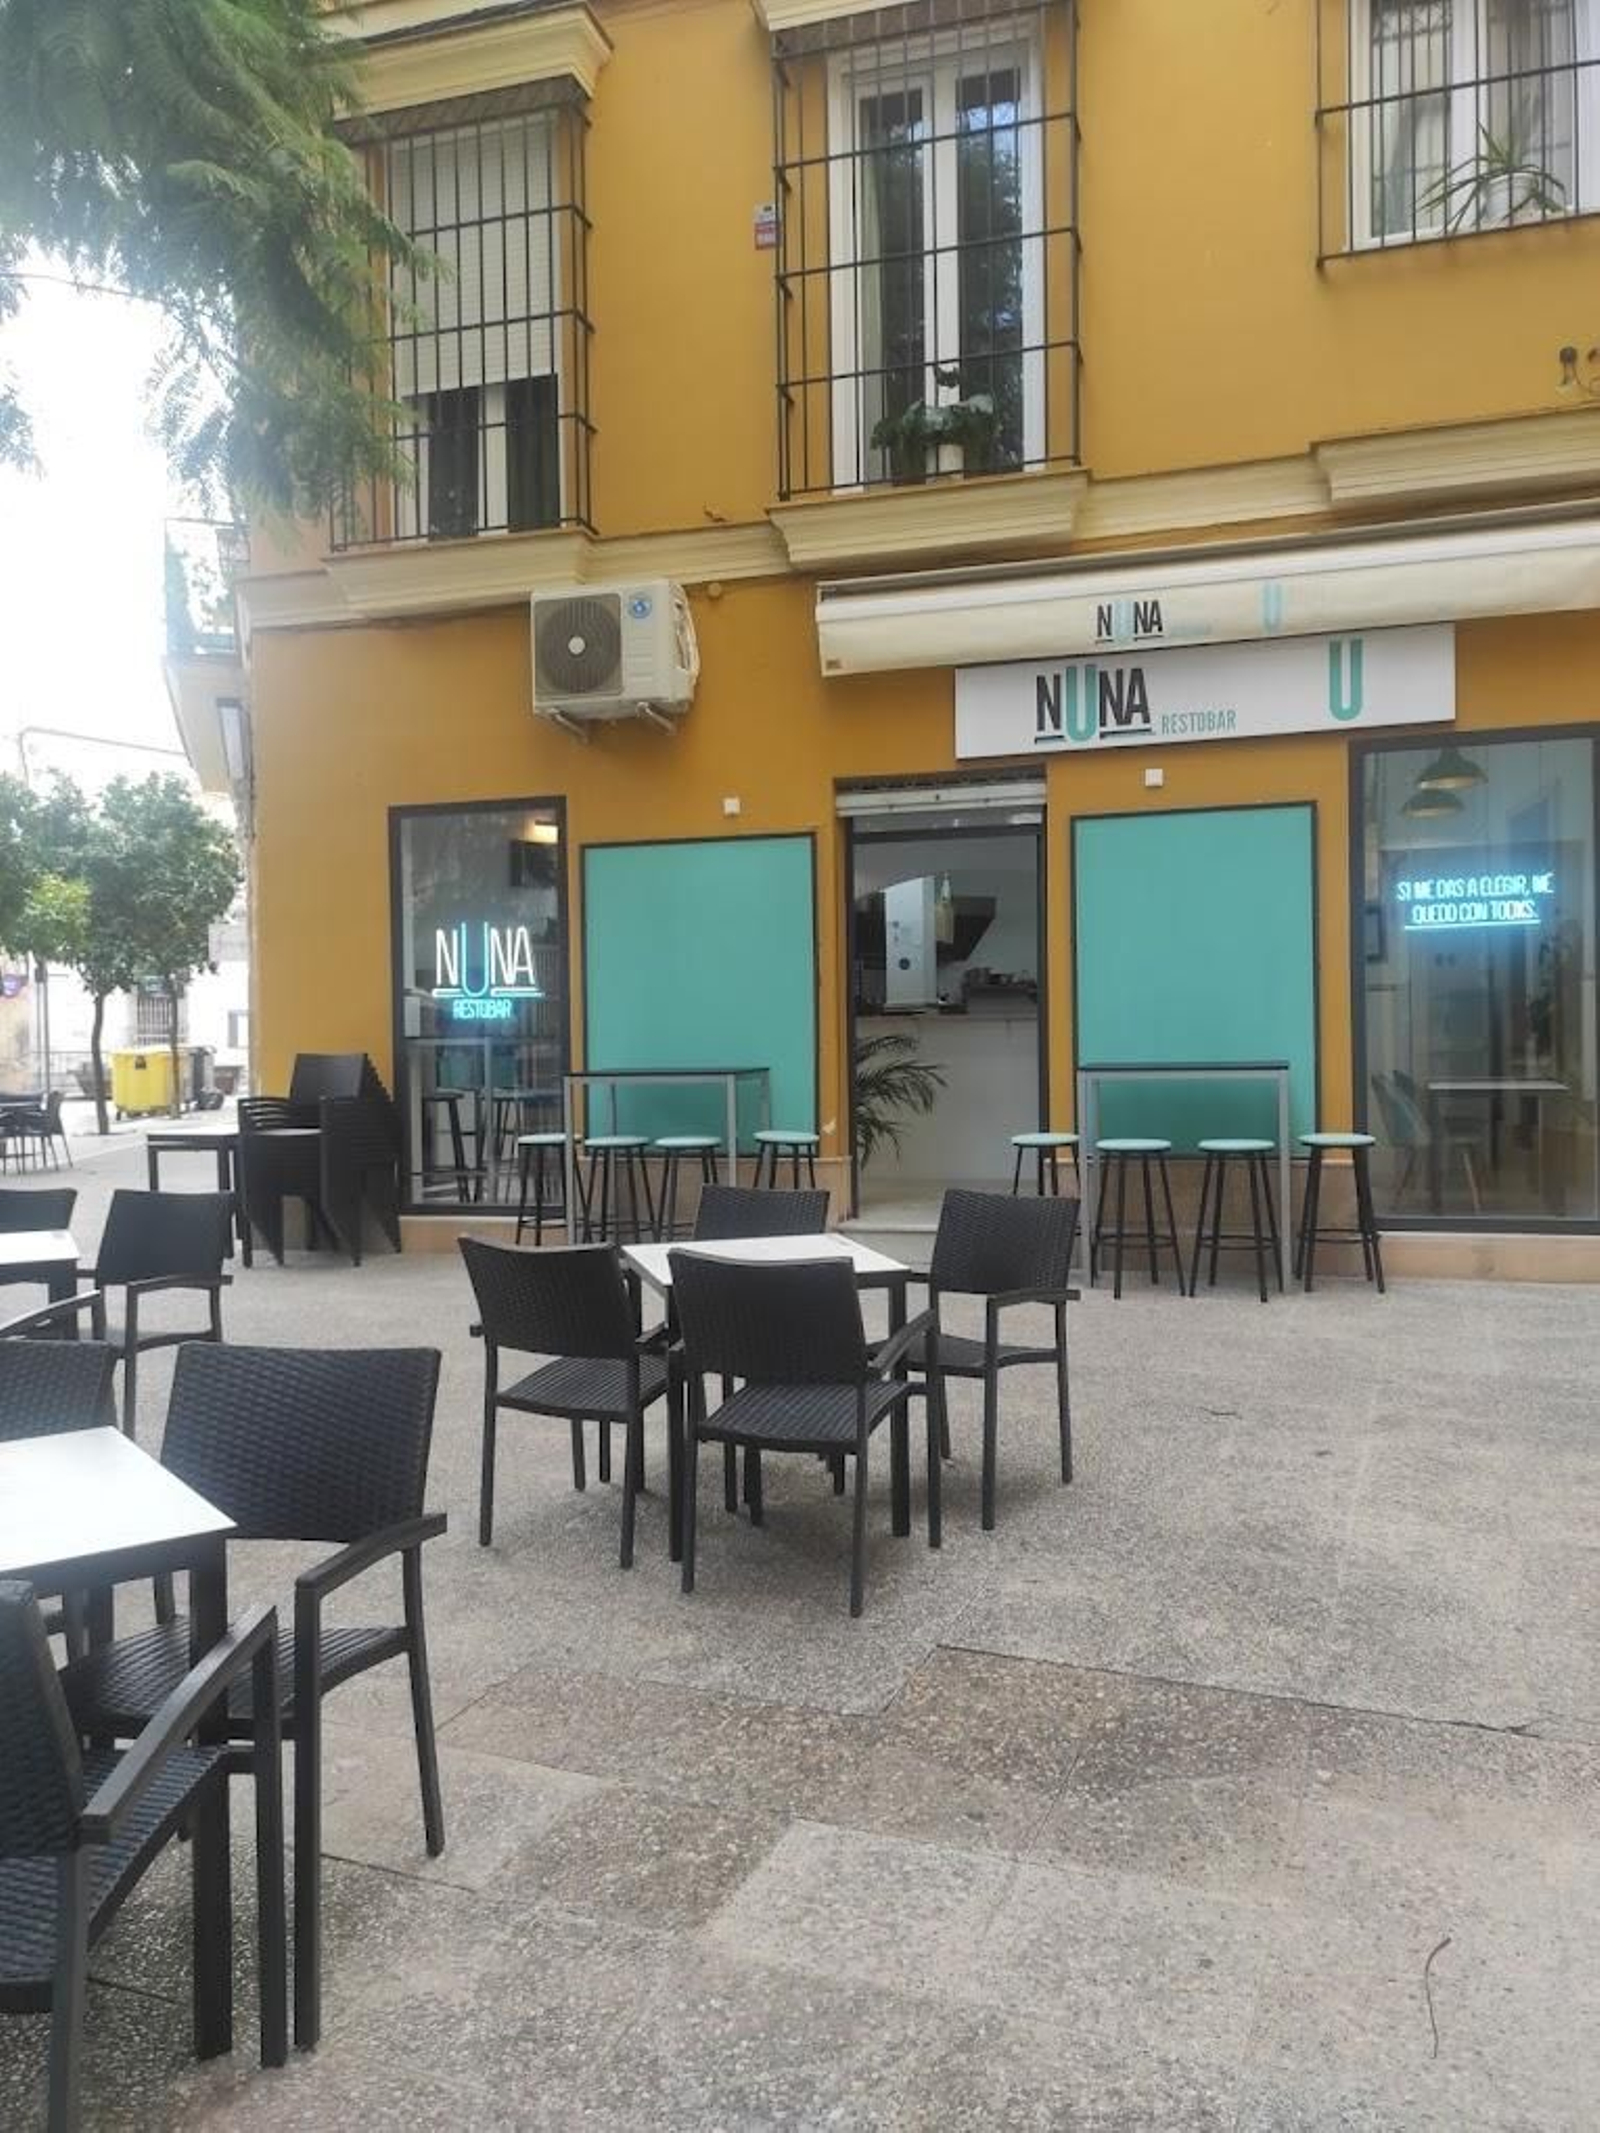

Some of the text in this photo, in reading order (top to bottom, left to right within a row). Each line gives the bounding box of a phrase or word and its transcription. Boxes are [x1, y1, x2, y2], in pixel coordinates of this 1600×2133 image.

[1328, 638, 1363, 721] U
[1035, 664, 1151, 743] NUNA
[1161, 709, 1237, 735] RESTOBAR
[1396, 881, 1411, 901] SI
[1414, 879, 1434, 899] ME
[1436, 878, 1465, 898] DAS
[1467, 878, 1478, 897] A
[1532, 872, 1554, 894] ME
[1412, 903, 1457, 924] QUEDO
[1459, 902, 1487, 922] CON
[435, 920, 536, 998] NUNA
[453, 999, 512, 1020] RESTOBAR
